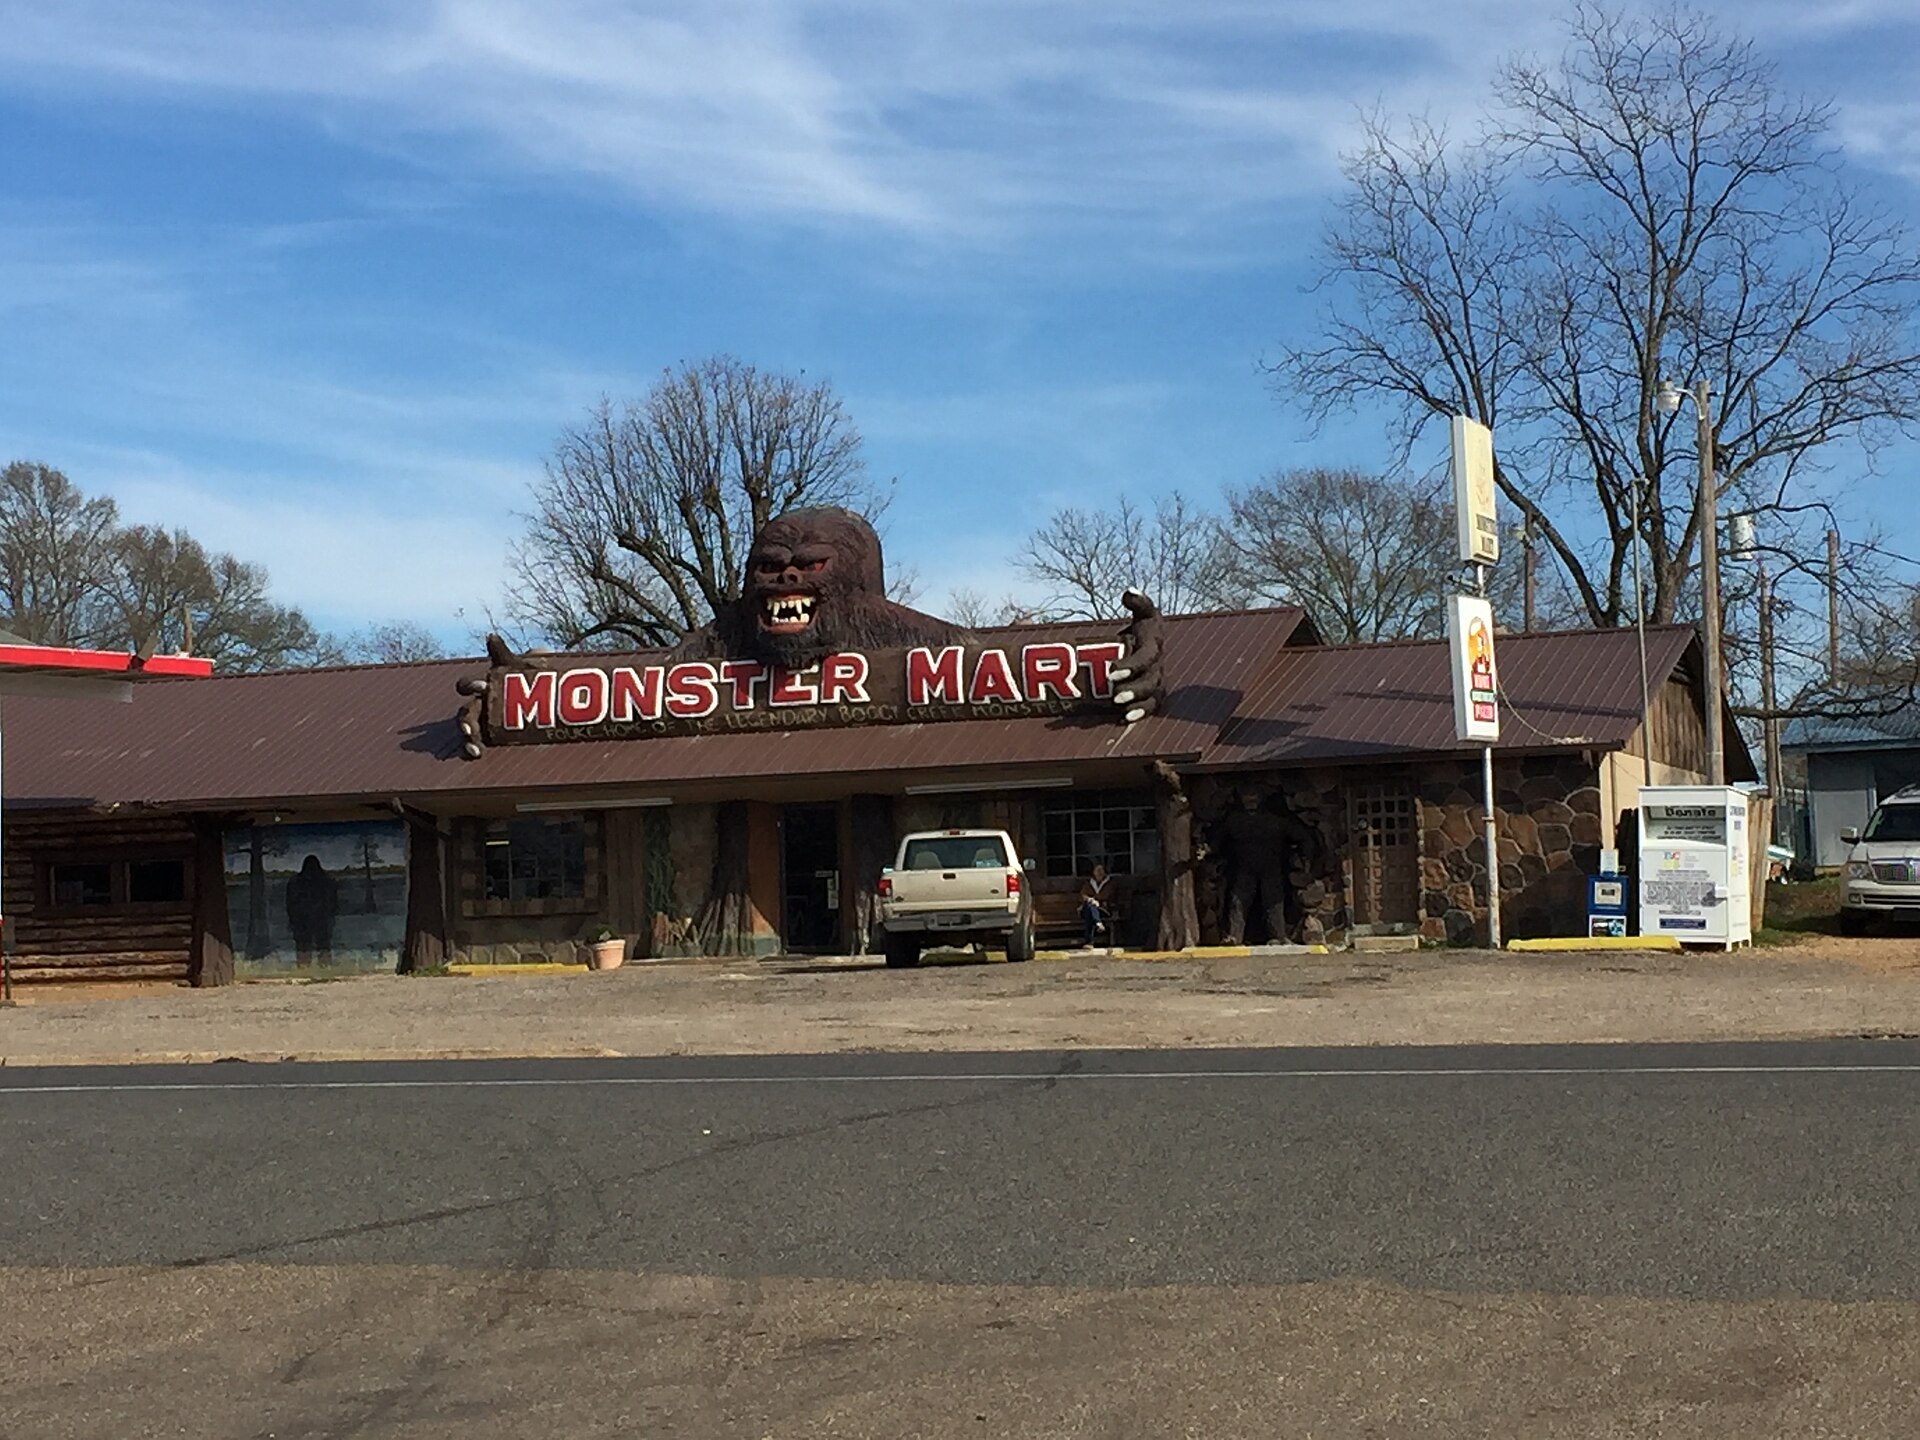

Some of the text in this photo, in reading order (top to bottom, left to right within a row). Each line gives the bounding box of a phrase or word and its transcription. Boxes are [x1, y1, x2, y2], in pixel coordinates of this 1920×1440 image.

[503, 642, 1125, 731] MONSTER MART
[545, 724, 598, 741] FOUKE
[603, 720, 648, 737] HOME
[687, 717, 720, 733] THE
[726, 707, 828, 729] LEGENDARY
[839, 704, 899, 723] BOGGY
[971, 699, 1075, 717] MONSTER
[1664, 805, 1716, 817] Donate
